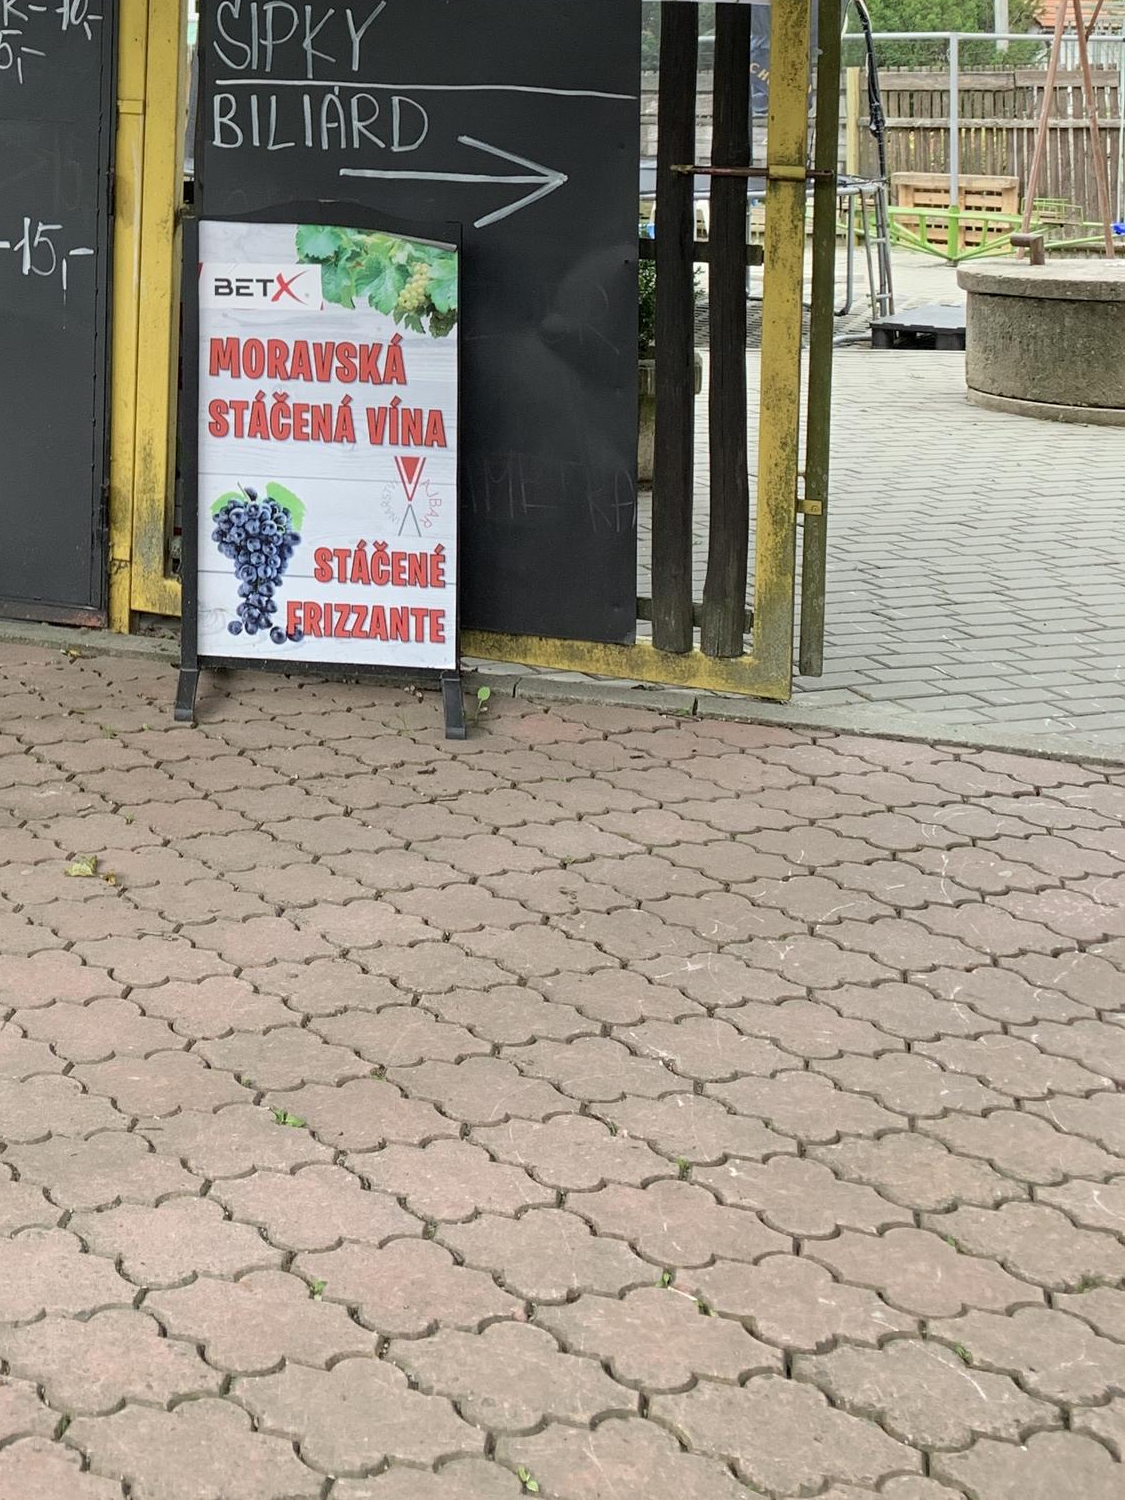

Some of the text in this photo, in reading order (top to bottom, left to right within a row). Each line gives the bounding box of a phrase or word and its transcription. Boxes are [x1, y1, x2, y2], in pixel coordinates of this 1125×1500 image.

[212, 86, 429, 152] BILIÁRD
[214, 269, 309, 306] BETX
[208, 332, 407, 385] MORAVSKÁ
[208, 390, 448, 448] STÁČENÁ VÍNA
[313, 539, 446, 588] STÁČENÉ
[286, 601, 446, 644] FRIZZANTE
